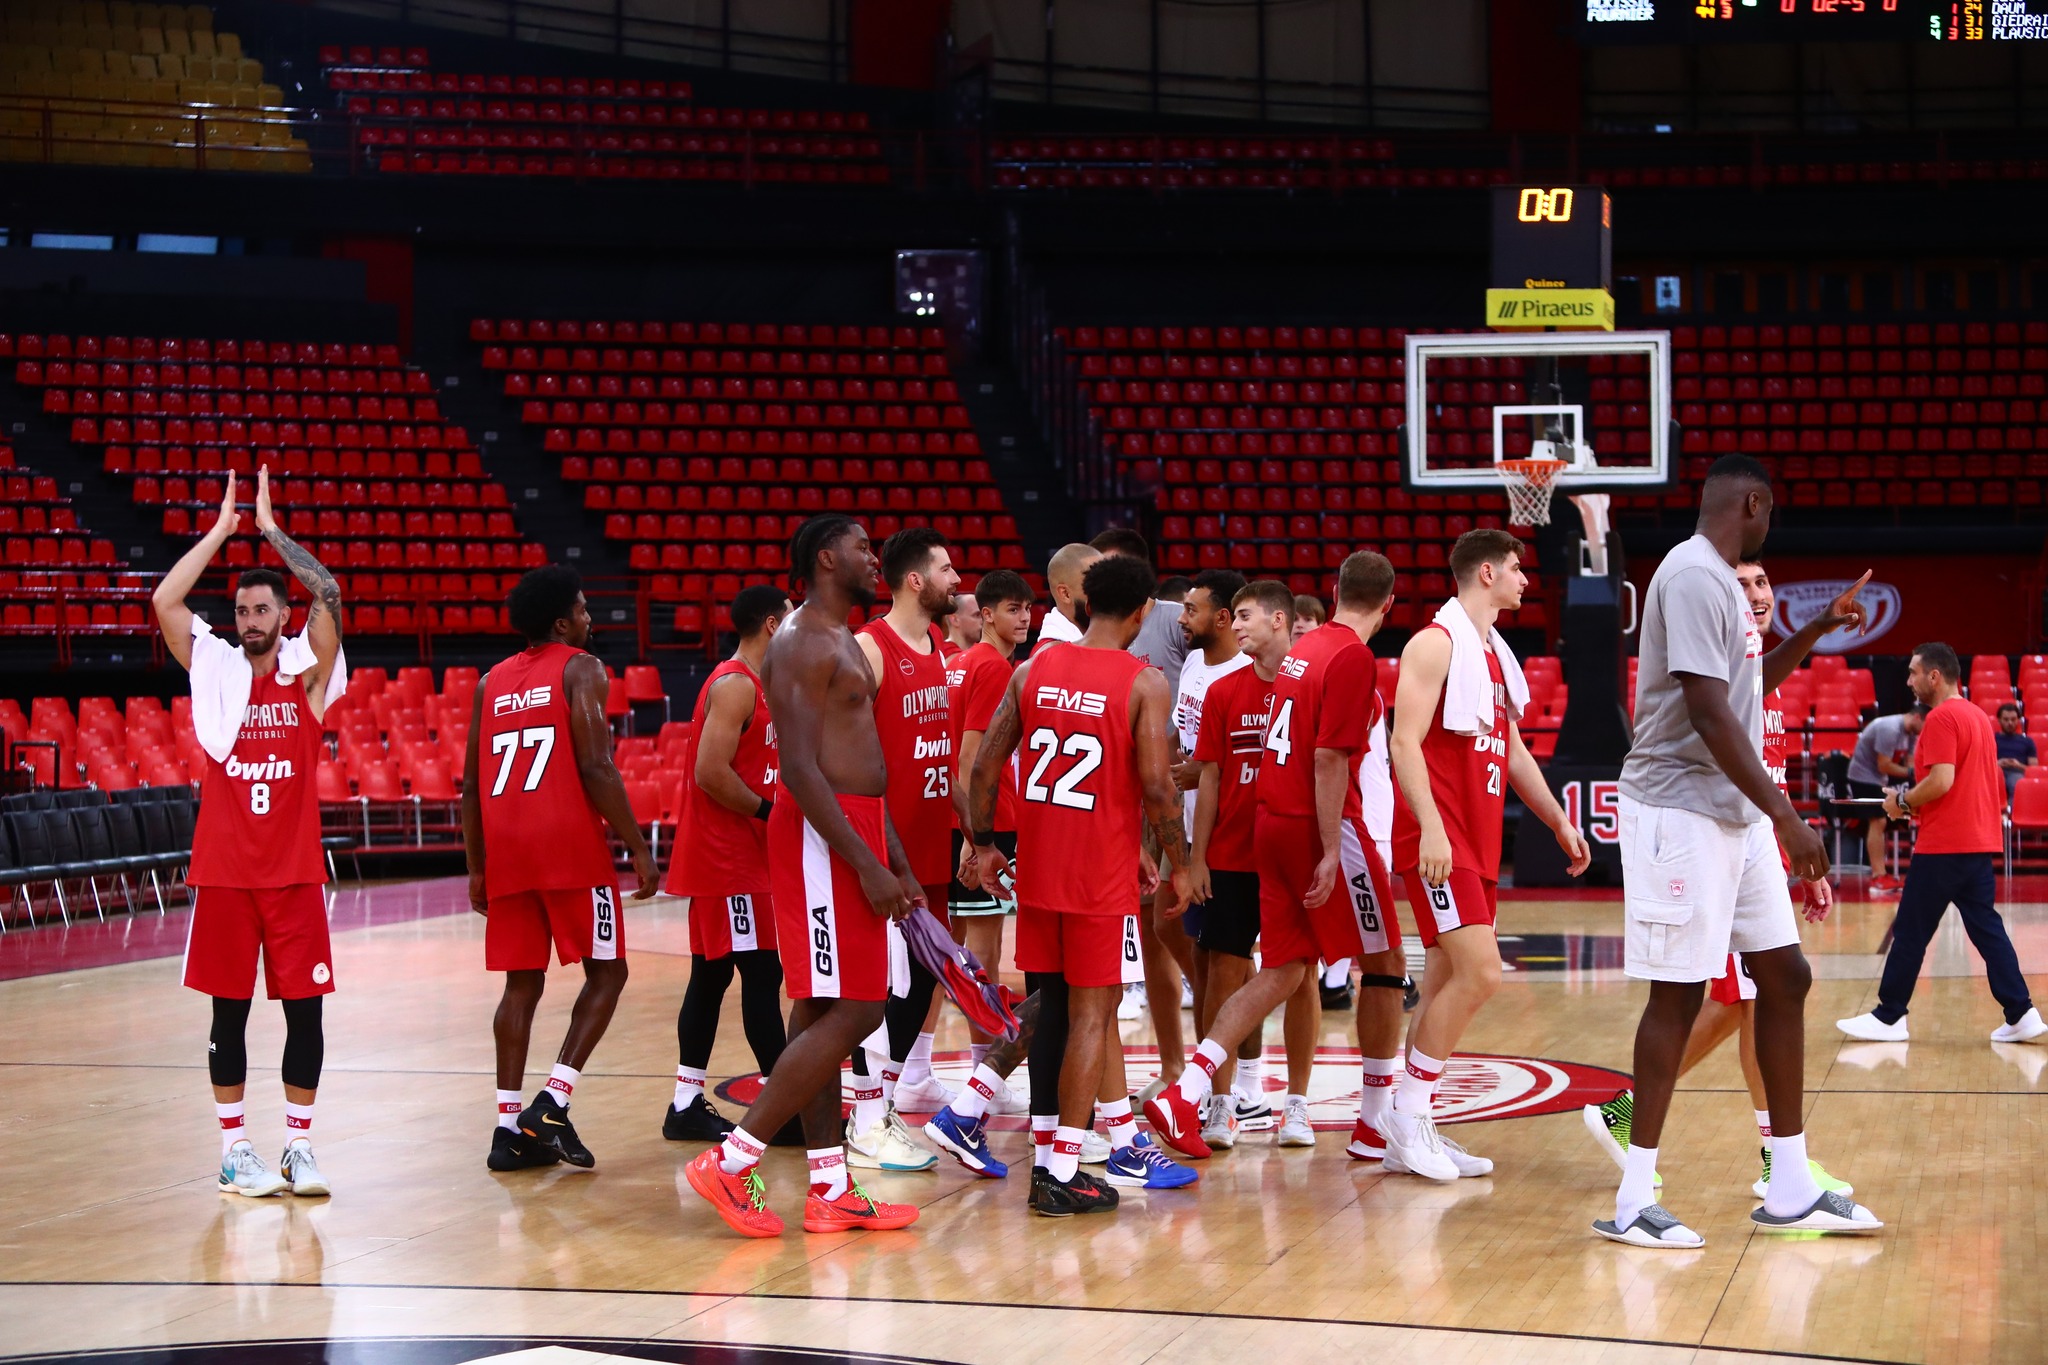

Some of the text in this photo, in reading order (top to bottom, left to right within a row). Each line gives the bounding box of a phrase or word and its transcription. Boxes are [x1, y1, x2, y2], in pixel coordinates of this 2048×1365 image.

[1991, 2, 2026, 14] DAUM
[1522, 300, 1595, 318] Piraeus
[1279, 655, 1310, 678] FMS
[494, 686, 552, 716] FMS
[1037, 686, 1108, 716] FMS
[1266, 693, 1294, 766] 4
[491, 726, 556, 798] 77
[1025, 727, 1103, 812] 22
[923, 766, 950, 799] 25
[1486, 762, 1501, 797] 20
[250, 782, 271, 815] 8
[1562, 781, 1620, 844] 15
[597, 886, 612, 941] GSA
[731, 894, 750, 935] GS
[1351, 872, 1380, 932] GSA
[811, 905, 833, 977] GSA
[1124, 917, 1138, 962] GS
[549, 1079, 570, 1092] GSA
[858, 1089, 882, 1100] GSA
[975, 1083, 994, 1100] GSA
[1364, 1075, 1386, 1085] GSA
[286, 1117, 303, 1128] SA
[1065, 1142, 1080, 1152] GS
